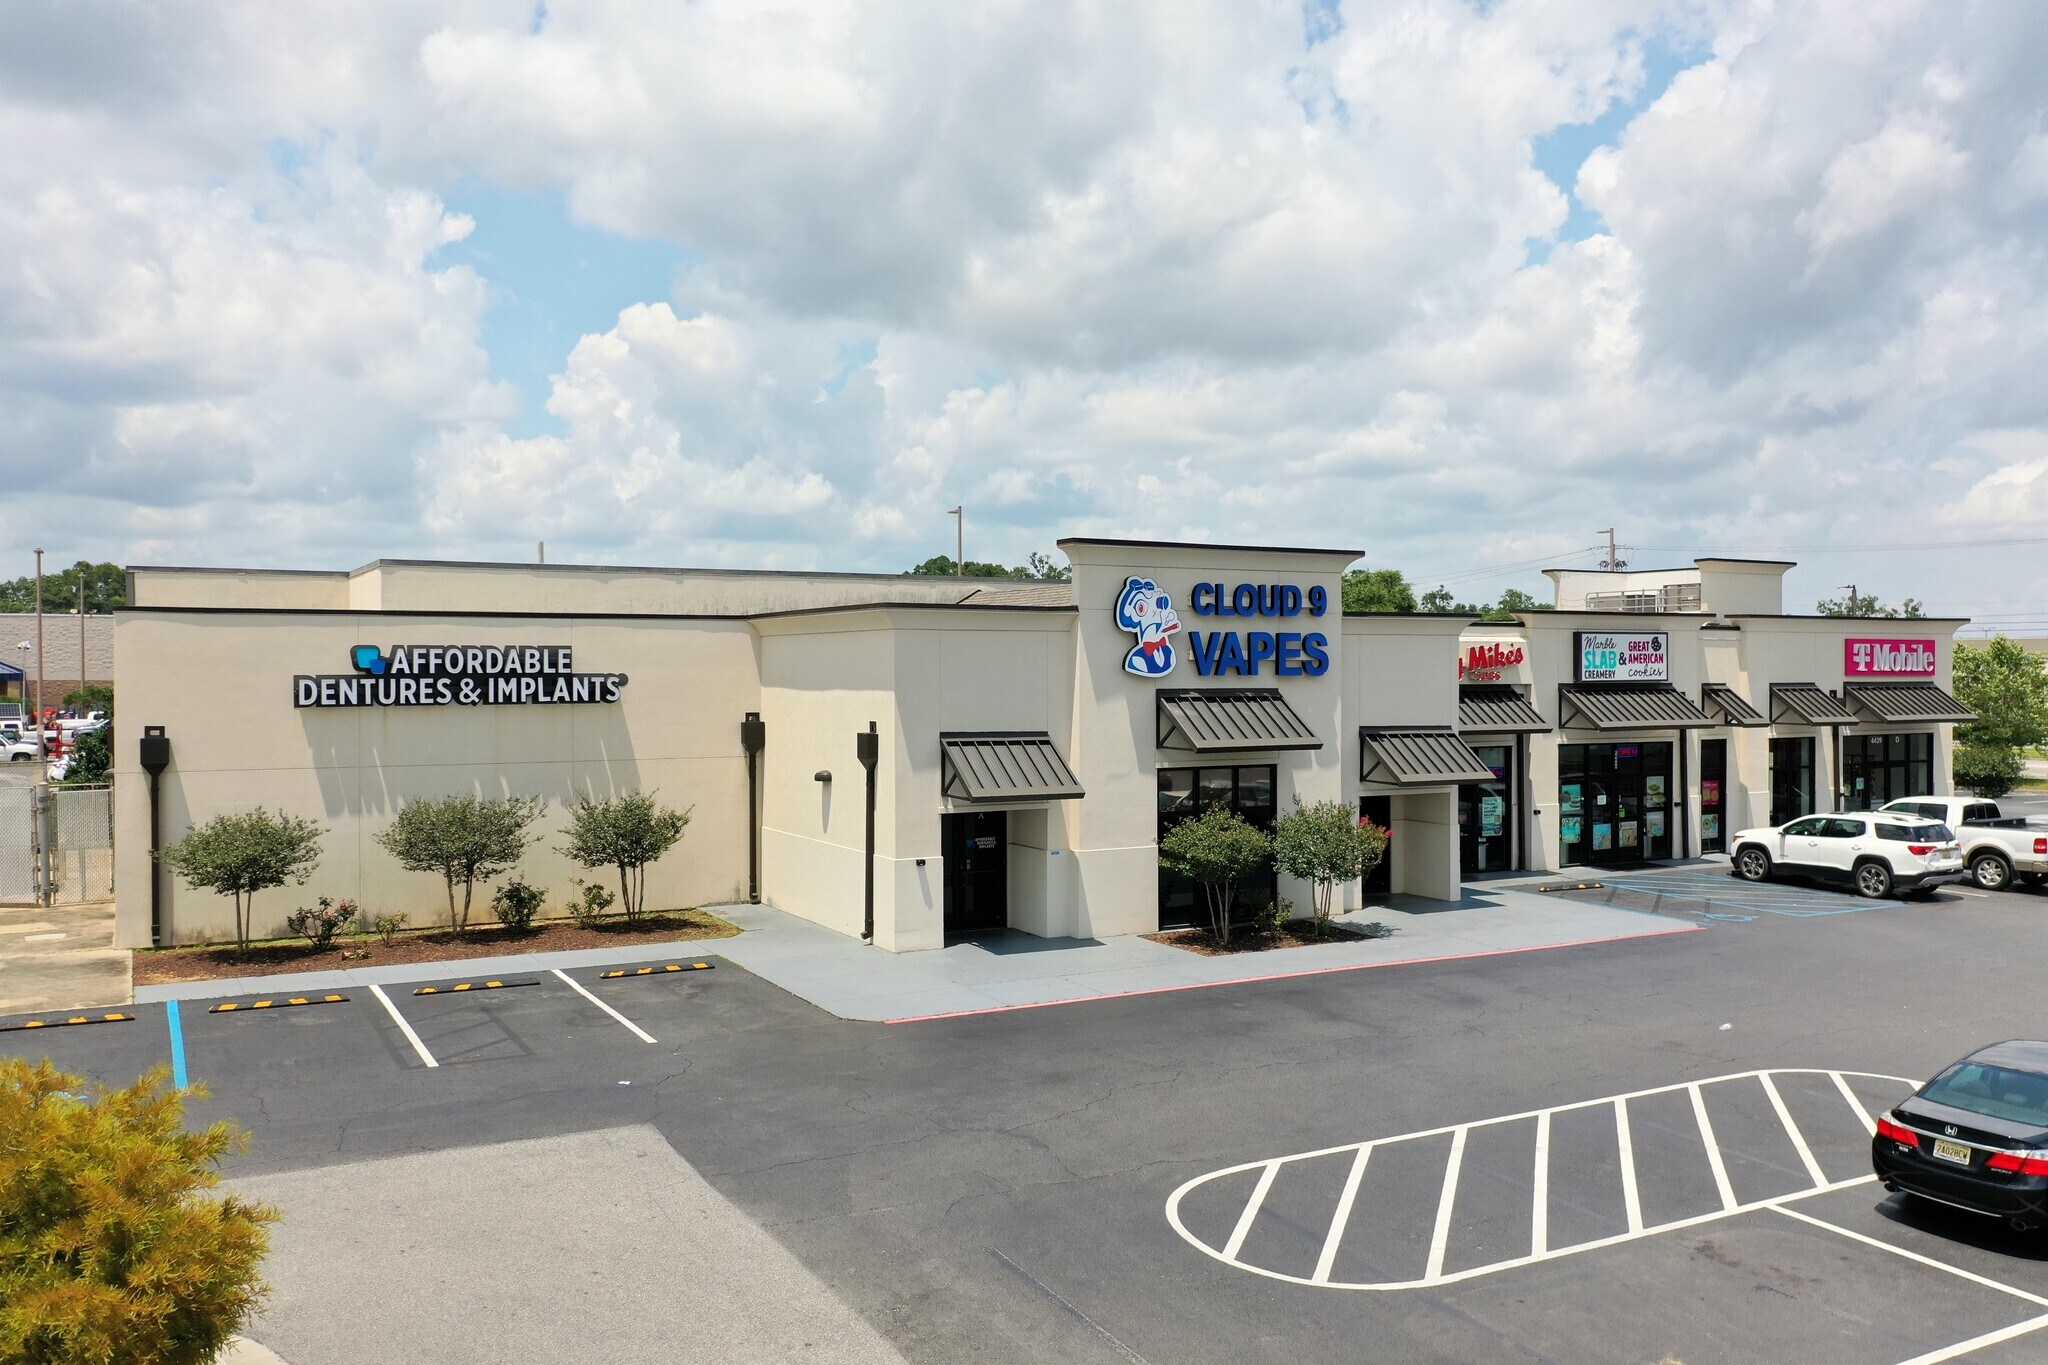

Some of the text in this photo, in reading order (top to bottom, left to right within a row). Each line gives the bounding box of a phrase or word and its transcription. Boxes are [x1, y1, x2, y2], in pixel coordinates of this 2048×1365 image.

[1191, 582, 1328, 617] CLOUD 9
[1584, 636, 1617, 651] Marble
[1628, 641, 1650, 652] GREAT
[390, 648, 572, 674] AFFORDABLE
[1188, 631, 1329, 677] VAPES
[1469, 643, 1524, 671] Mike's
[1584, 651, 1617, 669] SLAB
[1618, 652, 1627, 666] &
[1628, 653, 1664, 664] AMERICAN
[1584, 670, 1616, 679] CREAMERY
[1628, 664, 1664, 677] cookies
[298, 676, 621, 706] DENTURES & IMPLANTS
